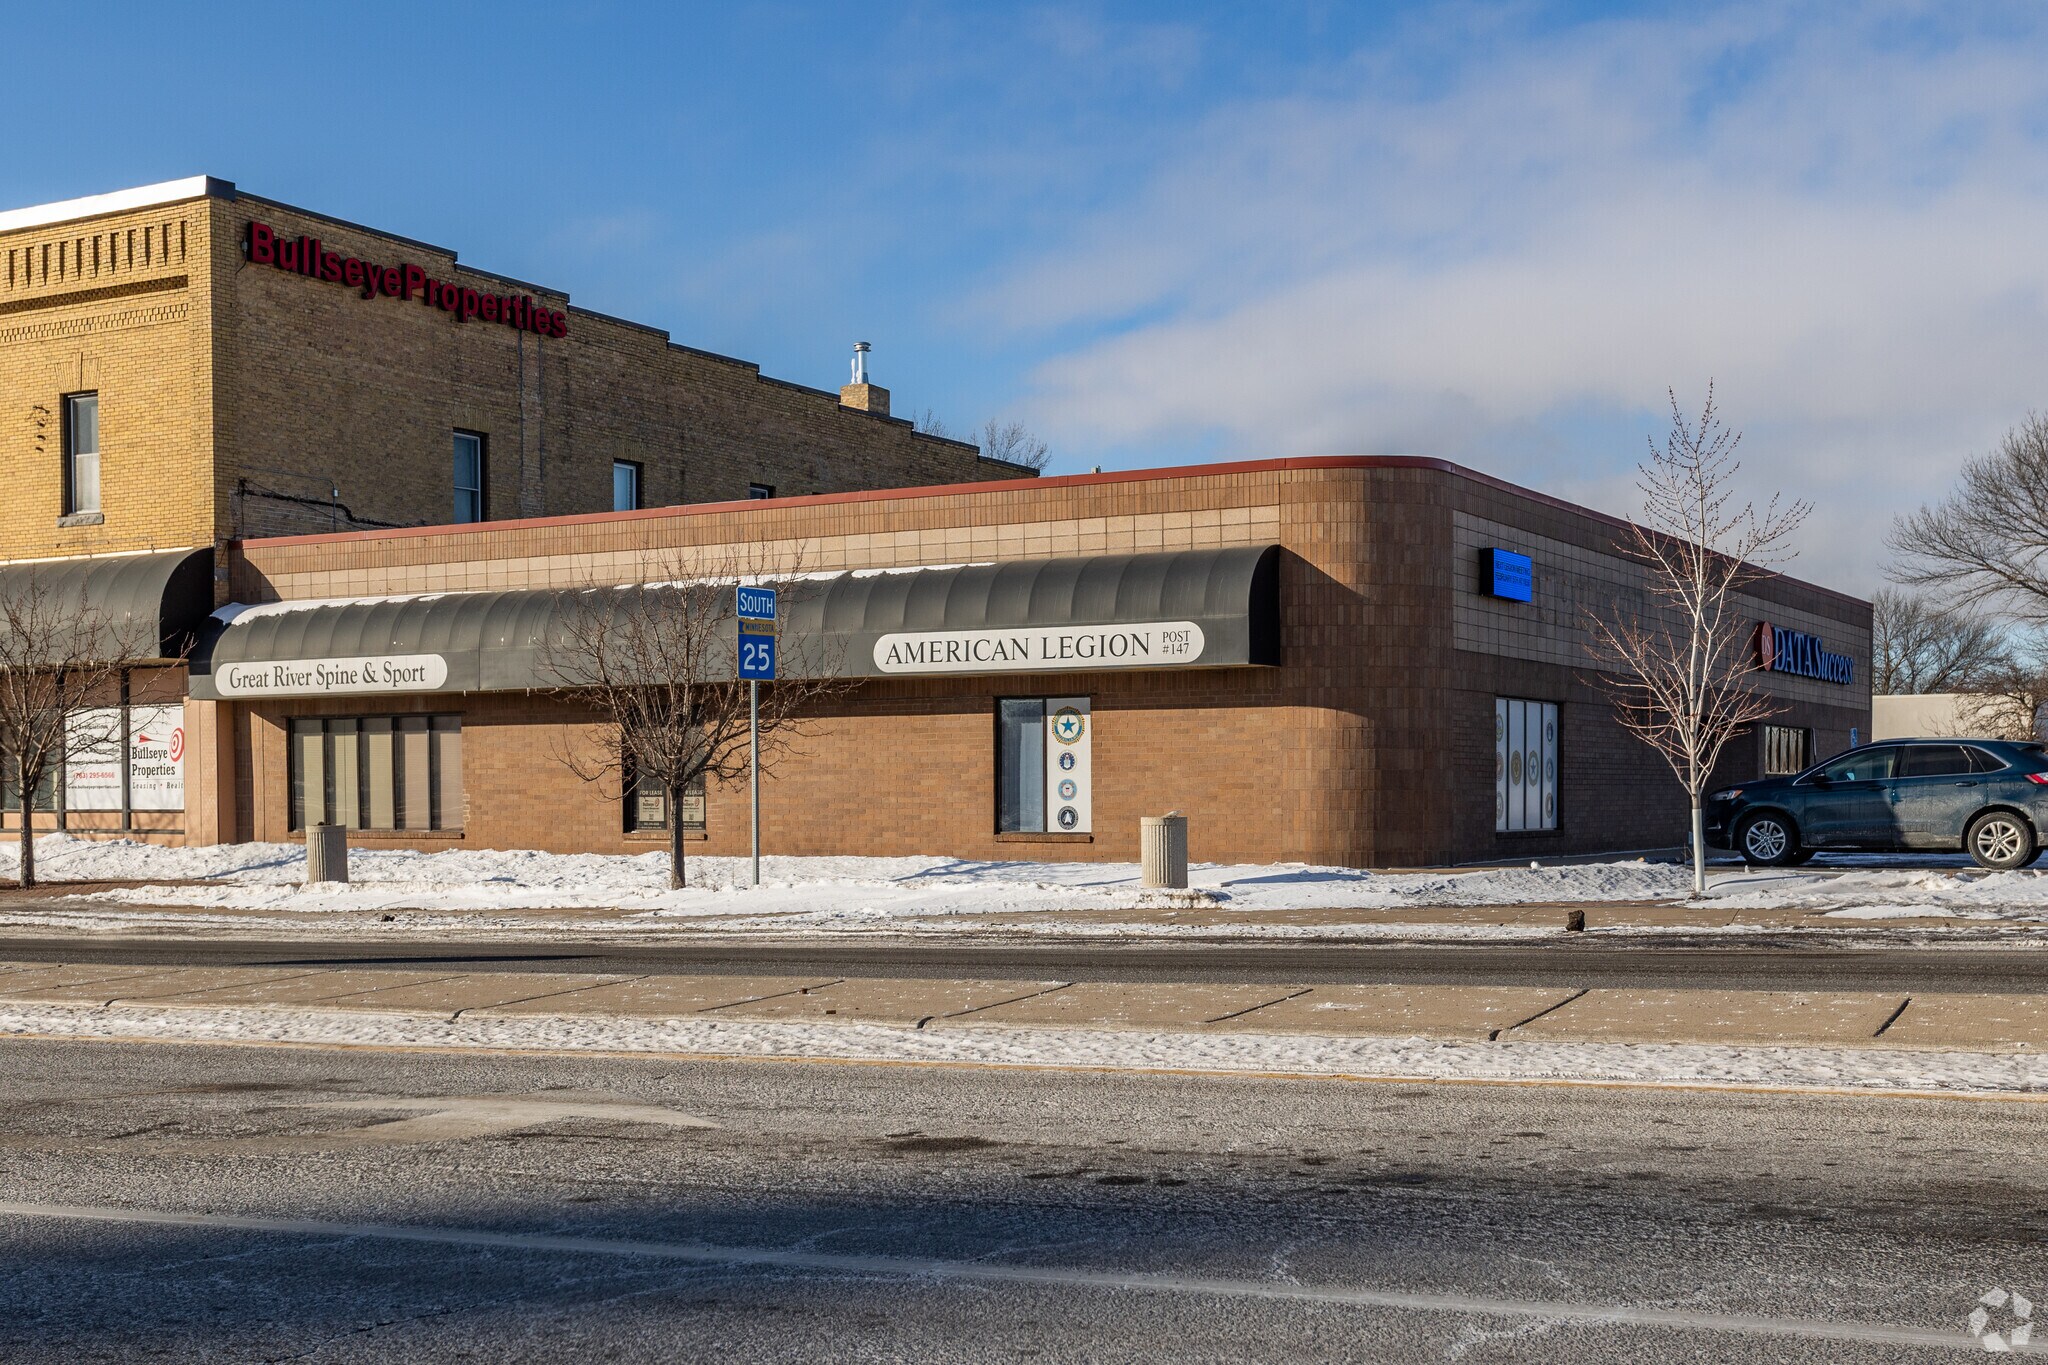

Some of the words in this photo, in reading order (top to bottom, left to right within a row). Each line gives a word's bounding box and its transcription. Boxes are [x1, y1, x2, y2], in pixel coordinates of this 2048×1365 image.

[740, 592, 773, 614] SOUTH
[745, 623, 774, 633] MINNESOTA
[1162, 630, 1191, 643] POST
[885, 638, 1030, 665] AMERICAN
[1041, 632, 1150, 660] LEGION
[1162, 643, 1190, 655] #147
[1762, 635, 1771, 655] DS
[743, 643, 770, 671] 25
[229, 667, 269, 689] Great
[273, 666, 312, 687] River
[316, 663, 358, 690] Spine
[362, 661, 379, 684] &
[383, 660, 425, 688] Sport
[132, 746, 168, 762] Bullseye
[132, 763, 176, 778] Properties
[132, 781, 157, 790] Leasing
